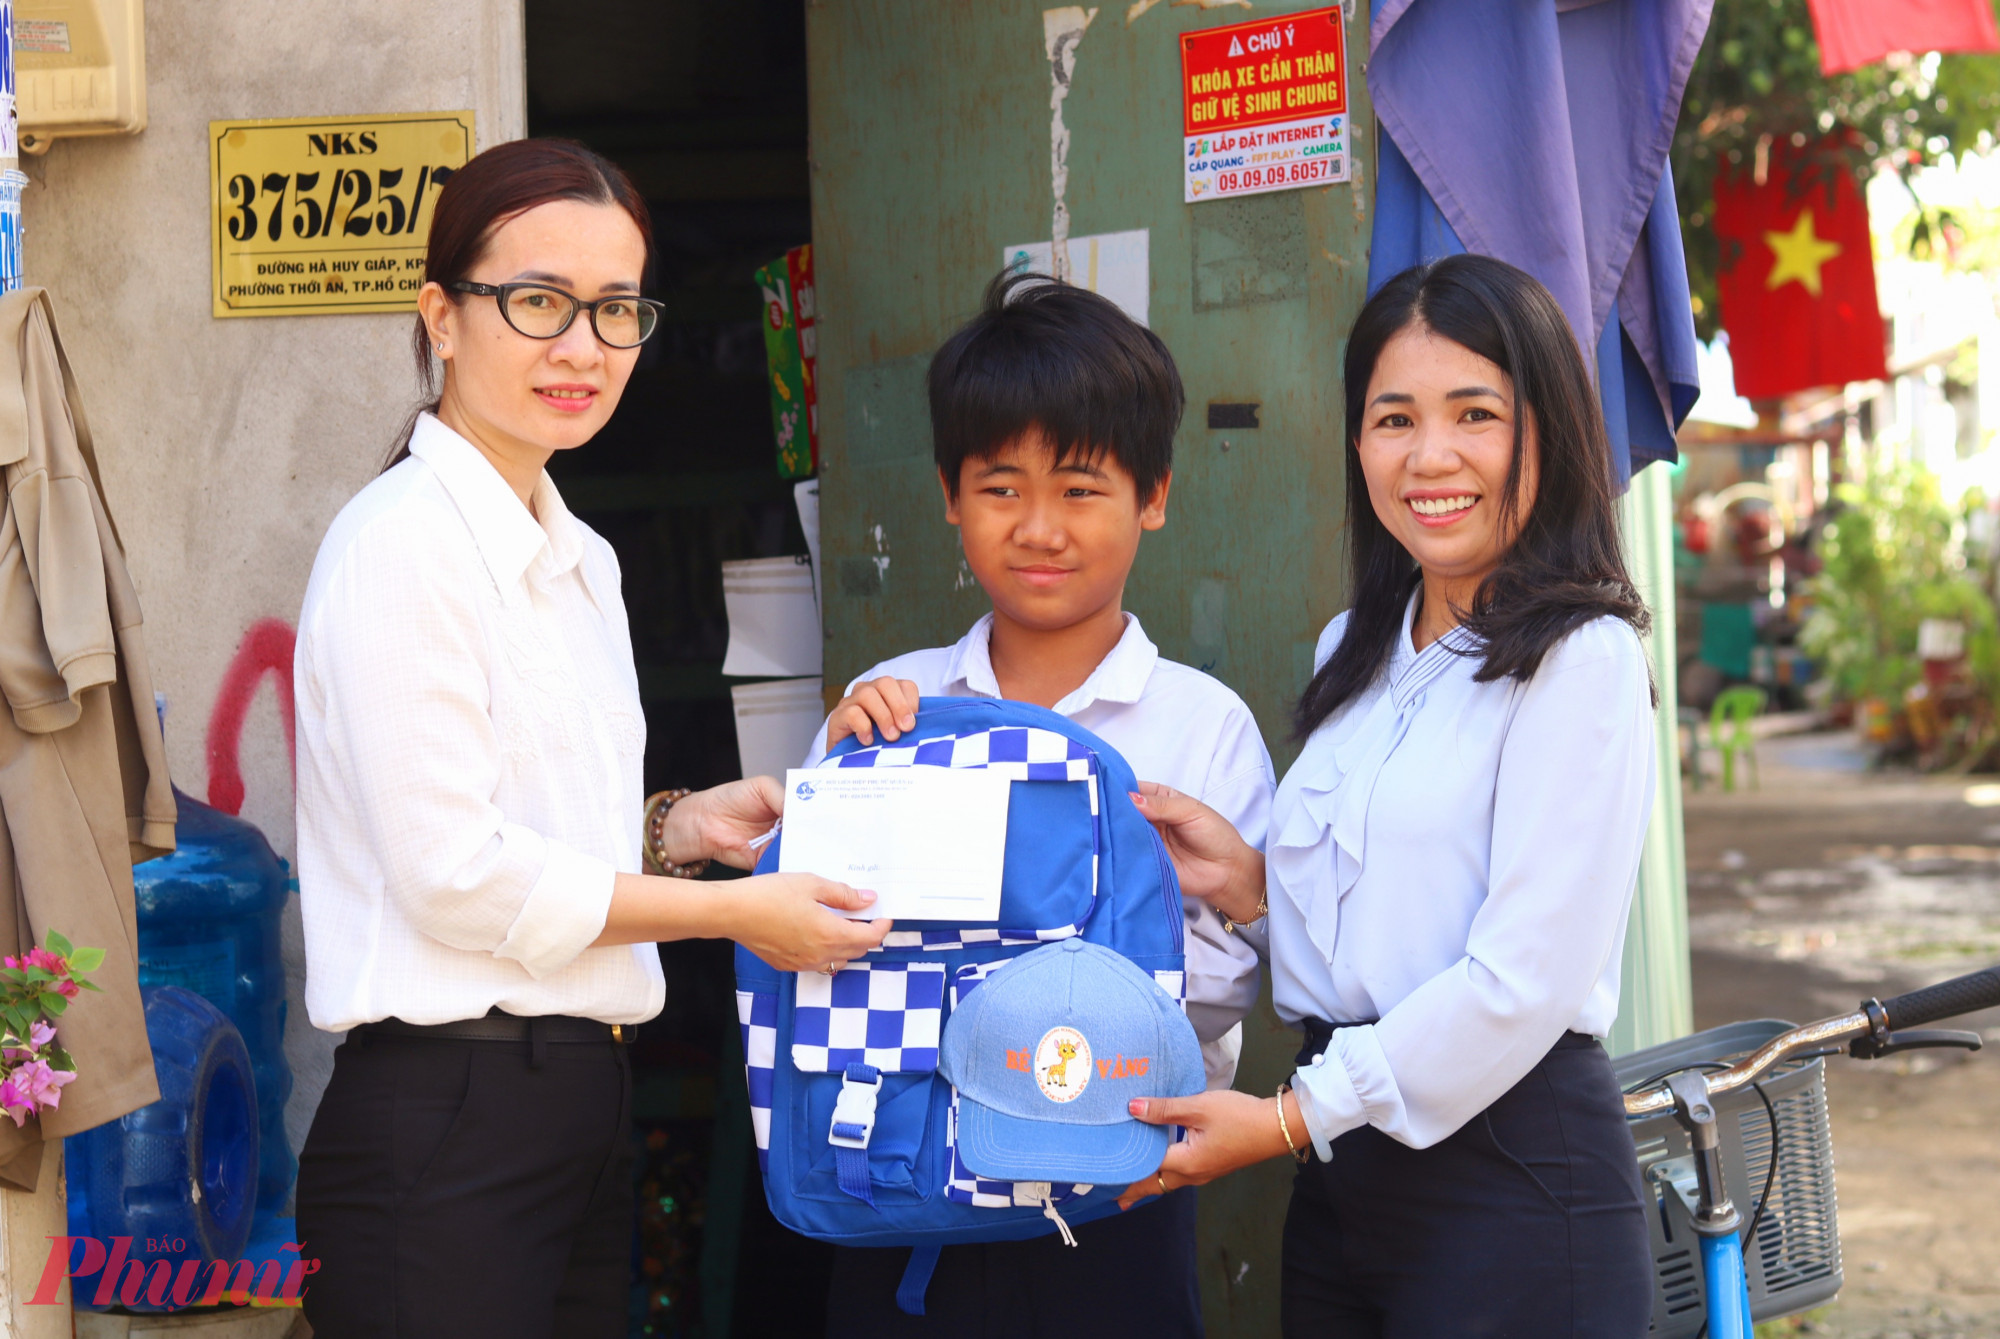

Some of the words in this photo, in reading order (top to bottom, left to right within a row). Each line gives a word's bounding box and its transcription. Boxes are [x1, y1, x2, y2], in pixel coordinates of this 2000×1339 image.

[1247, 26, 1281, 53] CHÚ
[1285, 23, 1295, 46] Ý
[1236, 65, 1256, 88] XE
[1260, 53, 1292, 84] CẨN
[1296, 50, 1336, 78] THẬN
[1191, 97, 1219, 122] GIỮ
[1222, 93, 1240, 121] VỆ
[1245, 90, 1282, 114] SINH
[1286, 81, 1338, 108] CHUNG
[306, 130, 378, 157] NKS
[1239, 131, 1264, 151] ĐẶT
[1267, 124, 1325, 145] INTERNET
[1189, 159, 1207, 172] CÁP
[1210, 156, 1244, 171] QUANG
[1251, 152, 1270, 164] FPT
[1271, 148, 1295, 161] PLAY
[1302, 142, 1343, 157] CAMERA
[1219, 160, 1329, 191] 09.09.09.6057
[257, 257, 305, 275] ĐƯỜNG
[309, 256, 328, 273] HÀ
[332, 260, 361, 273] HUY
[364, 256, 401, 273] GIÁP,
[228, 280, 285, 297] PHƯỜNG
[289, 278, 322, 295] THỚI
[325, 281, 349, 295] AN,
[352, 275, 395, 293] TP.HỒ
[1005, 1046, 1032, 1073] BÉ
[1068, 1077, 1088, 1100] BABY
